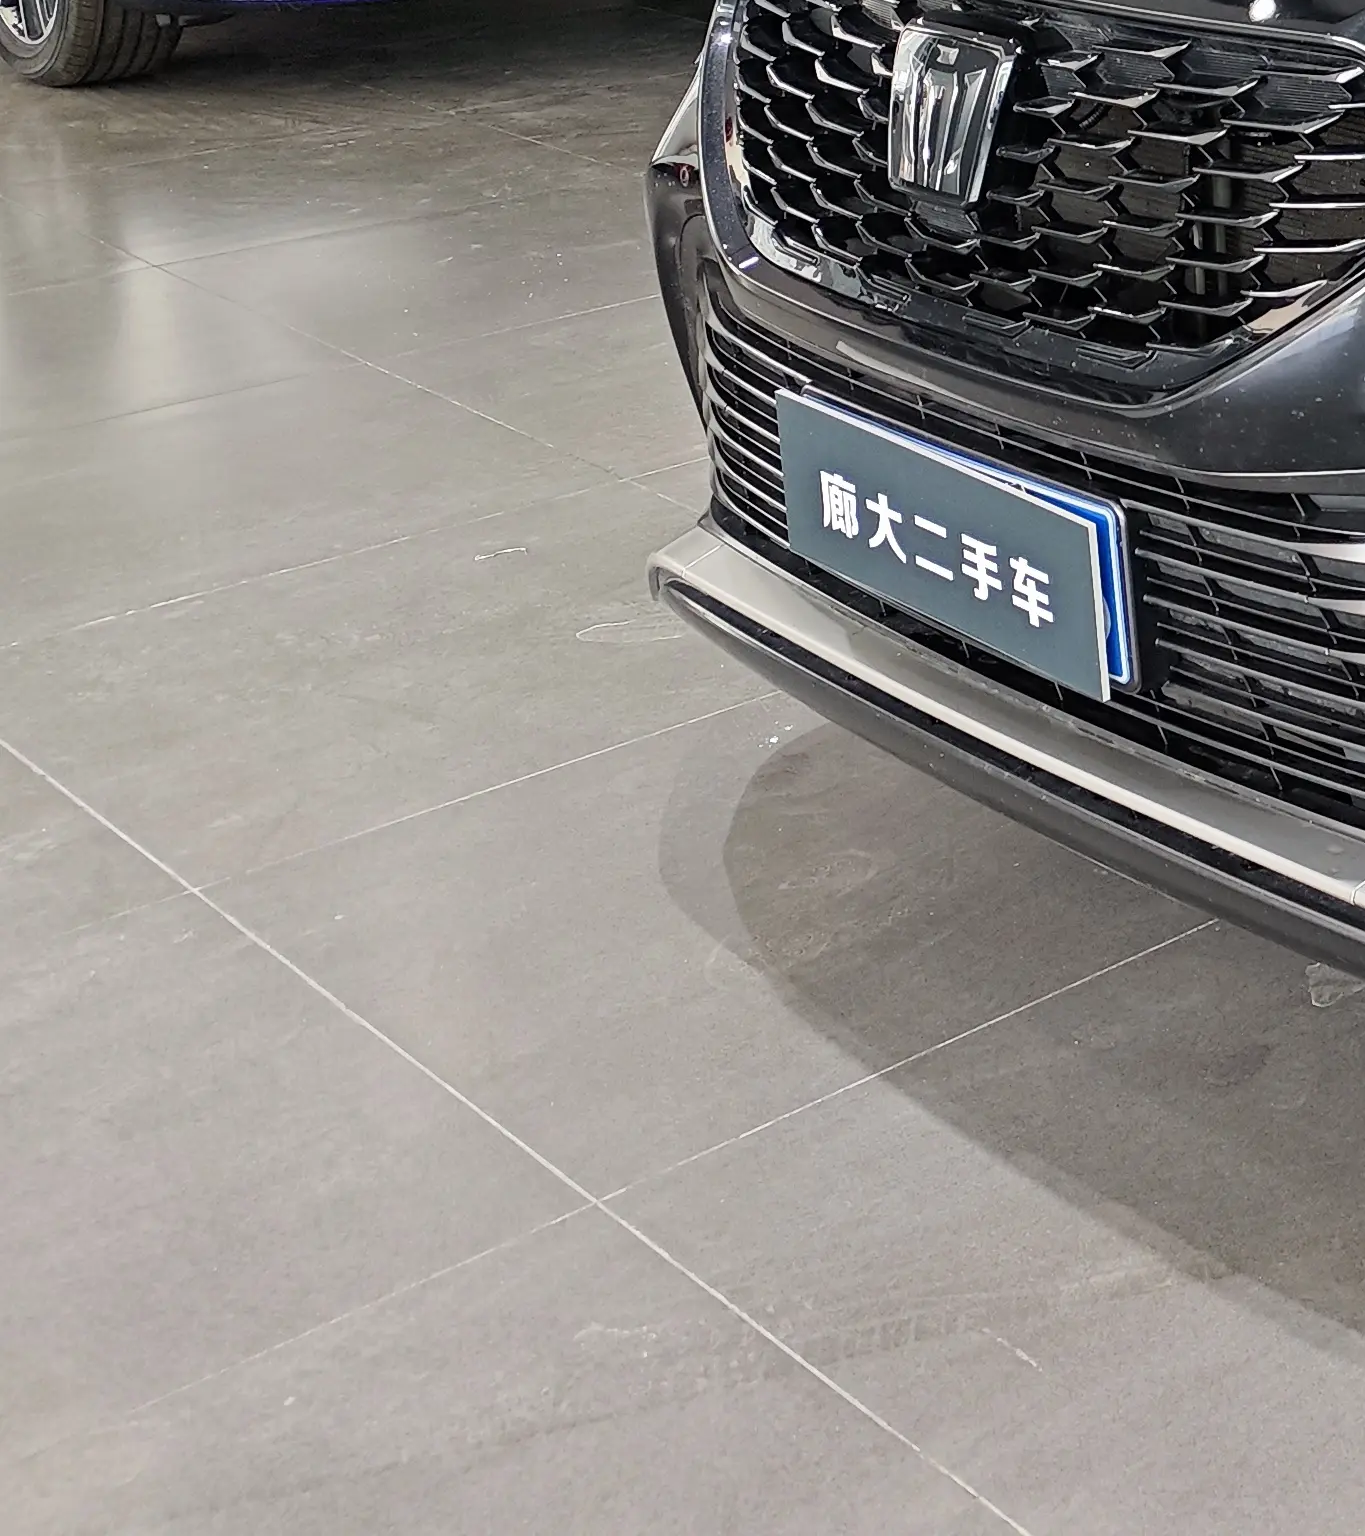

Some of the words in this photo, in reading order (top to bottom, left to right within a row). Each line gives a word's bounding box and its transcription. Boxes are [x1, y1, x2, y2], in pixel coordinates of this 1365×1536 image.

[818, 469, 1055, 628] 廊大二手车
